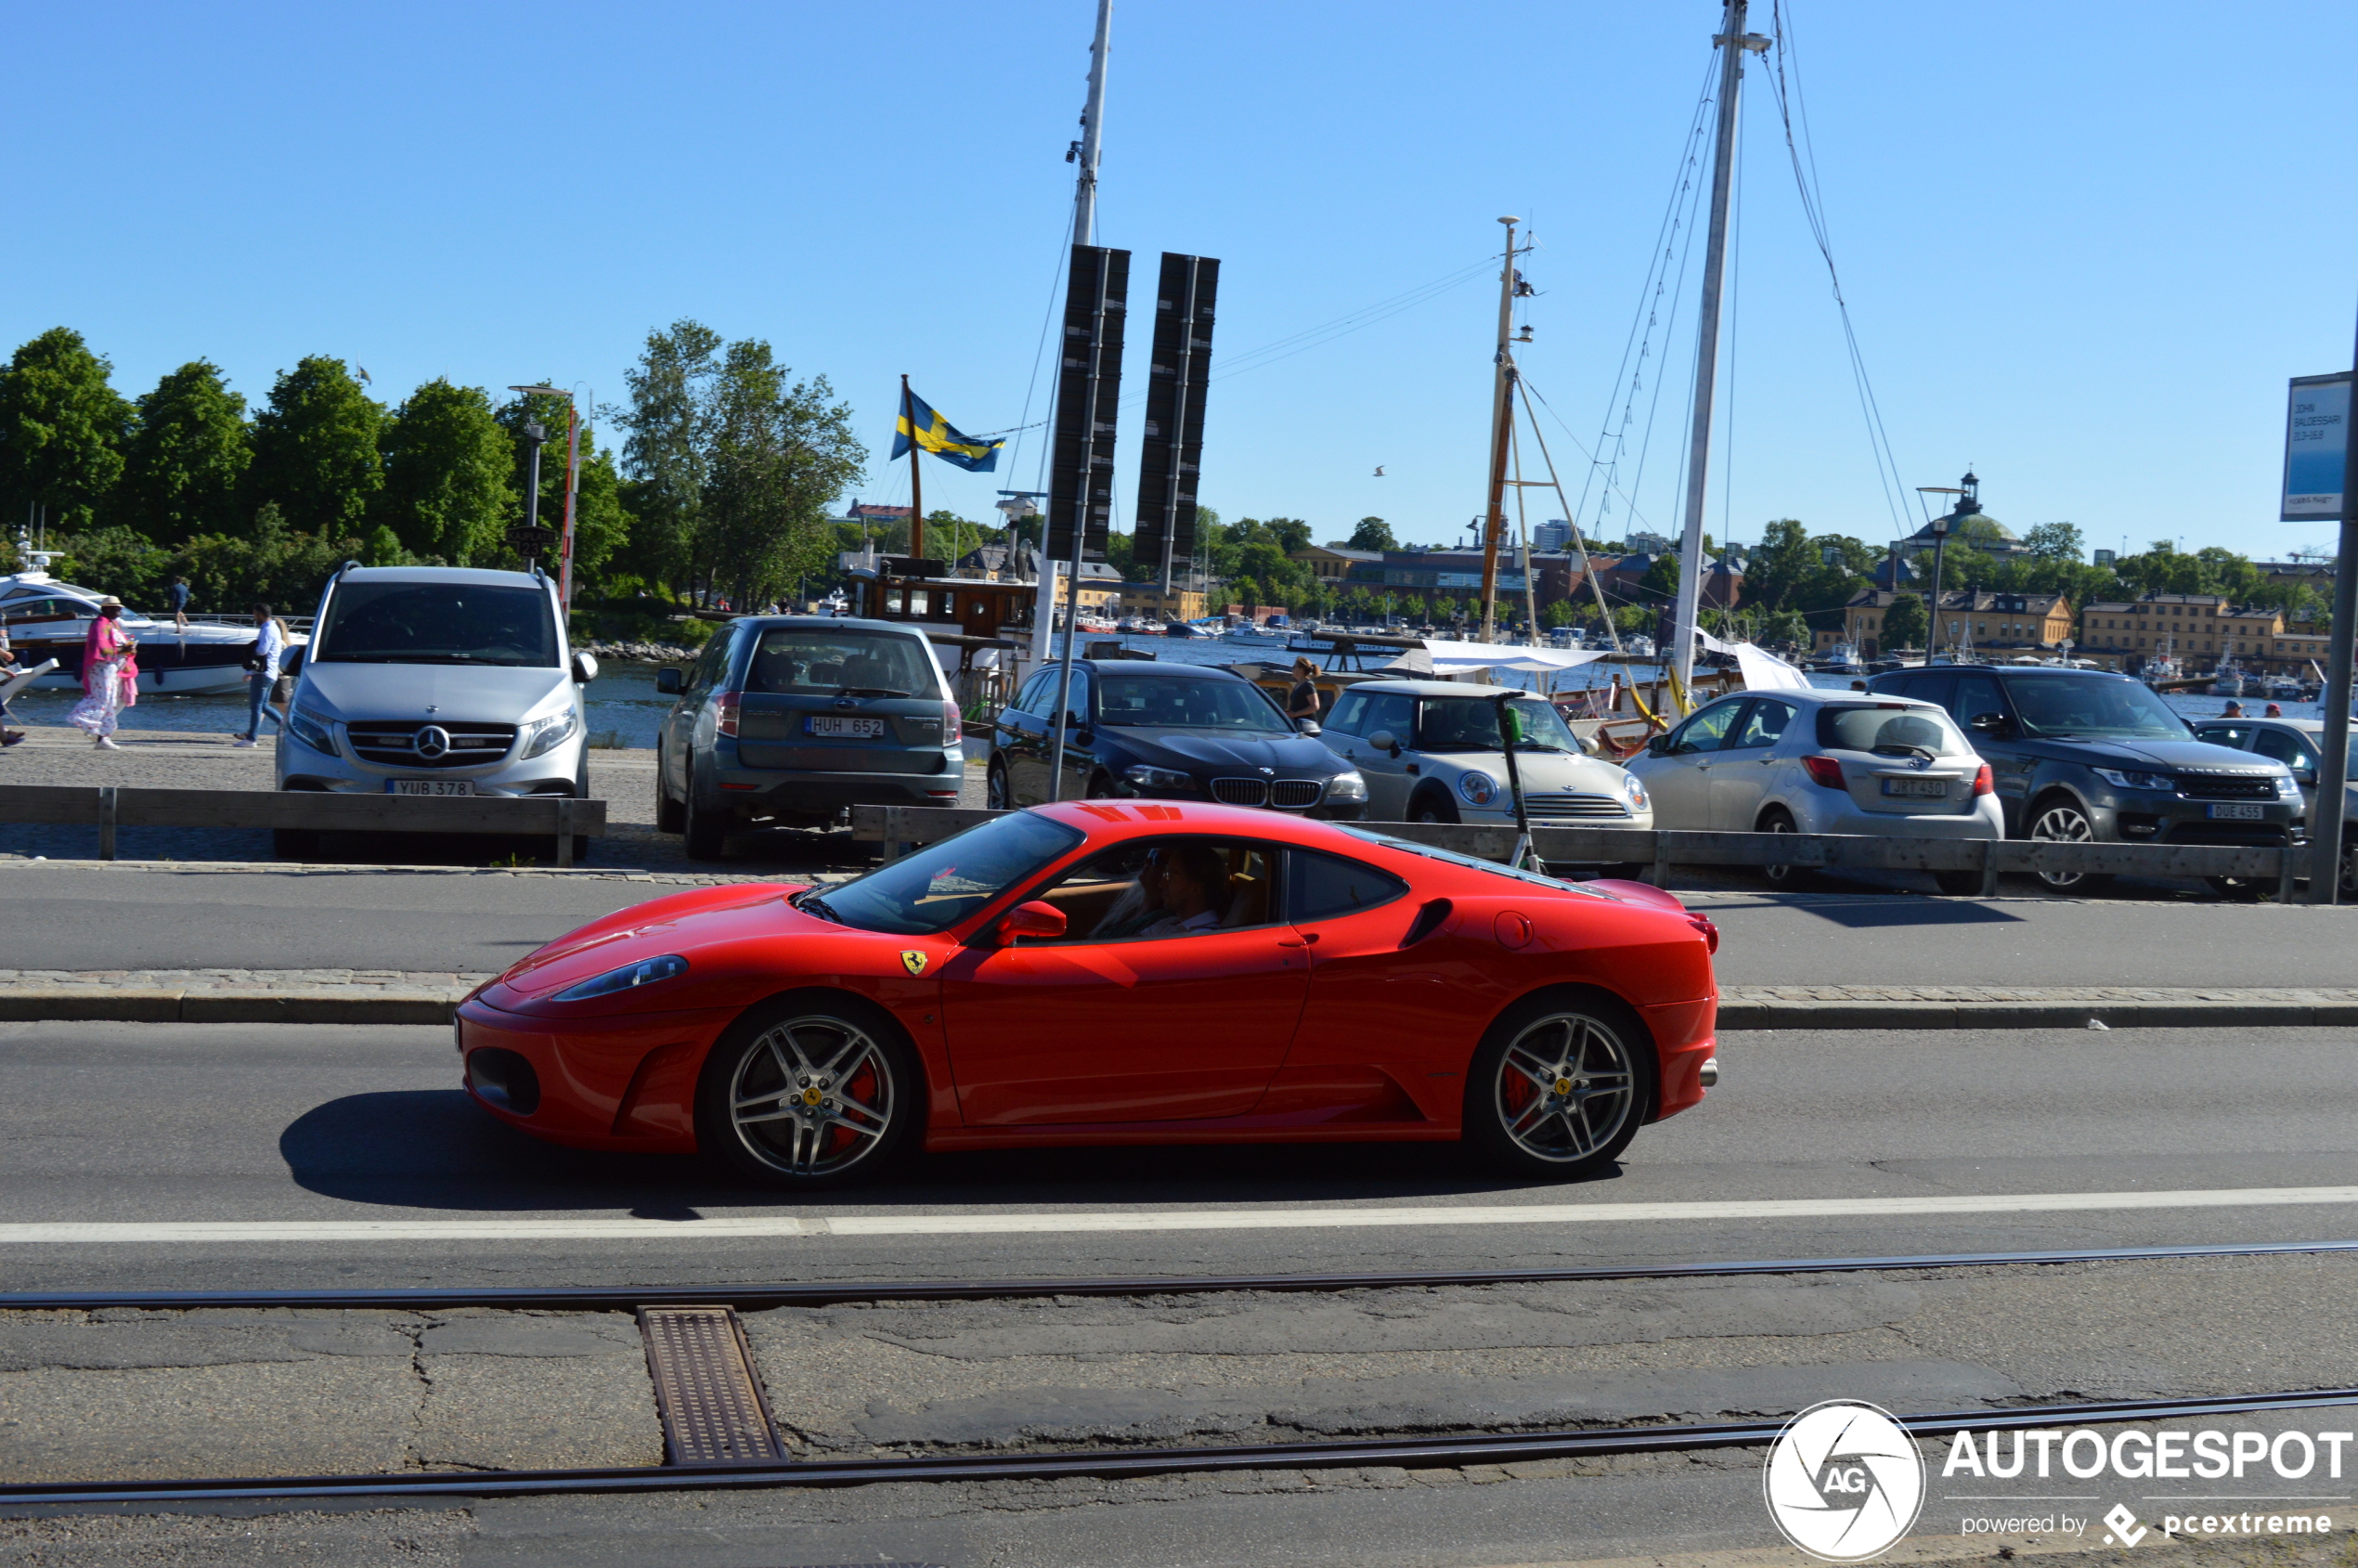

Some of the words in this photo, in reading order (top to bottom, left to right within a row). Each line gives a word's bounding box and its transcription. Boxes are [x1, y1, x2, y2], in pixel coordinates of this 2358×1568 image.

[2295, 403, 2315, 414] JOHN
[522, 542, 539, 556] 23
[813, 718, 842, 732] HUH
[852, 719, 881, 734] 652
[2177, 767, 2222, 775] RANGE
[400, 782, 430, 796] YUB
[435, 783, 466, 797] 378
[1894, 781, 1917, 793] JRT
[1920, 782, 1942, 795] 430
[2215, 806, 2235, 818] DUE
[2238, 806, 2260, 818] 455
